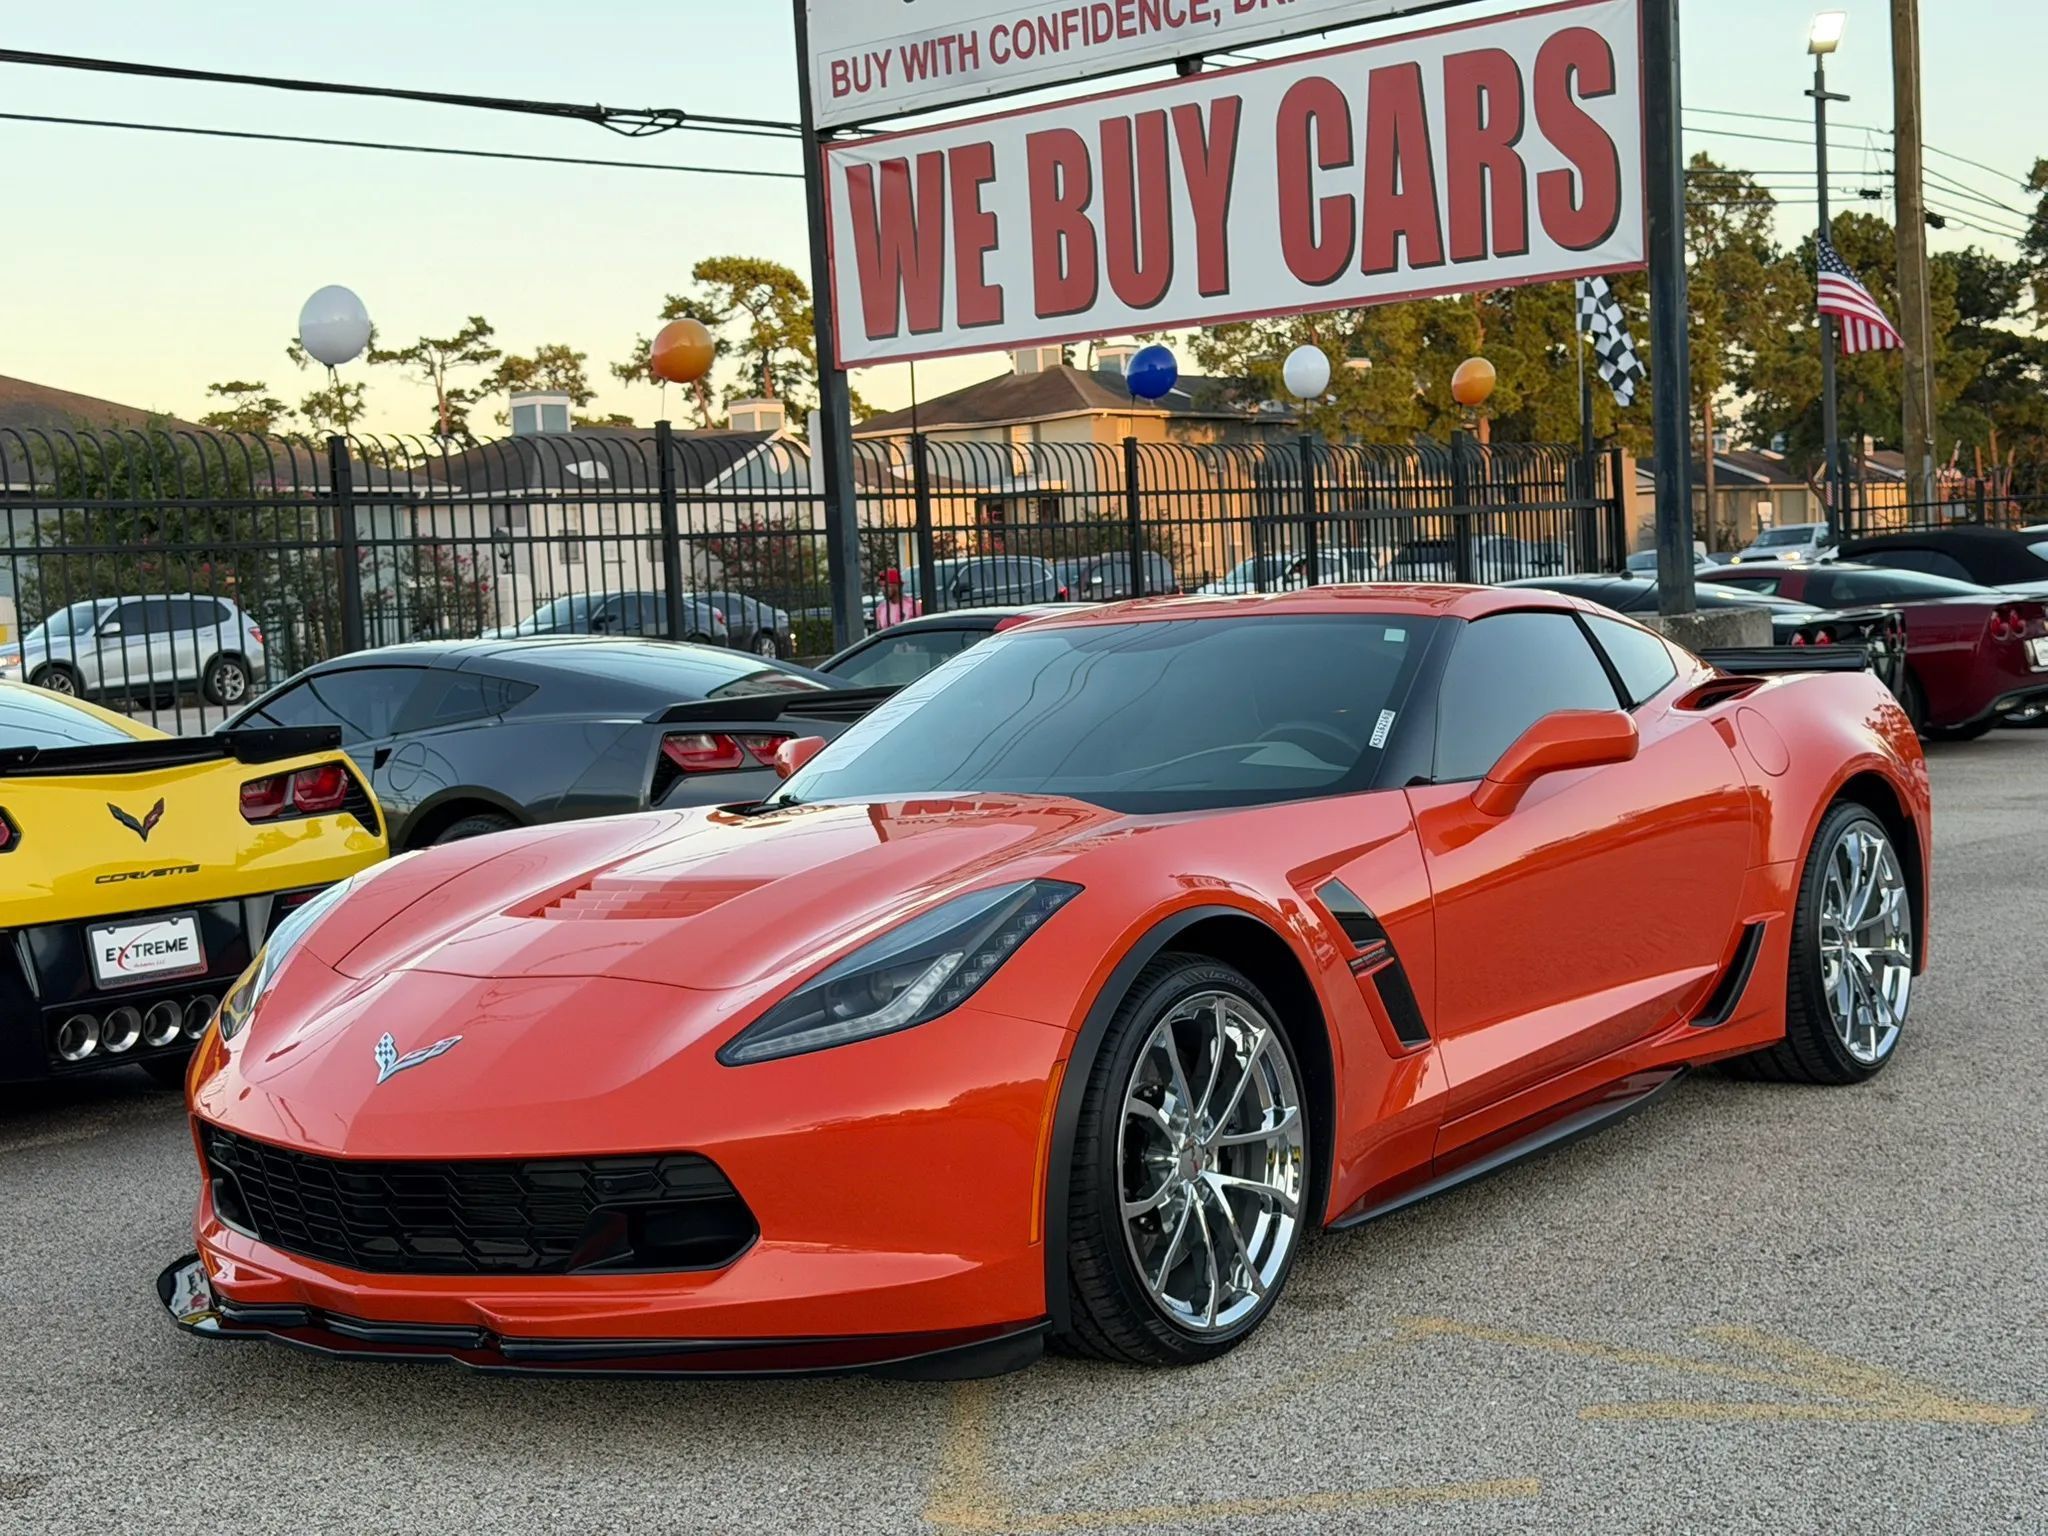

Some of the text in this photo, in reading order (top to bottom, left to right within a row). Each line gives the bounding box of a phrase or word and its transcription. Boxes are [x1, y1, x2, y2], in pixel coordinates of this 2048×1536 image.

[830, 49, 892, 98] BUY
[899, 30, 980, 83] WITH
[845, 26, 1622, 341] WE BUY CARS
[105, 936, 189, 962] EXTREME
